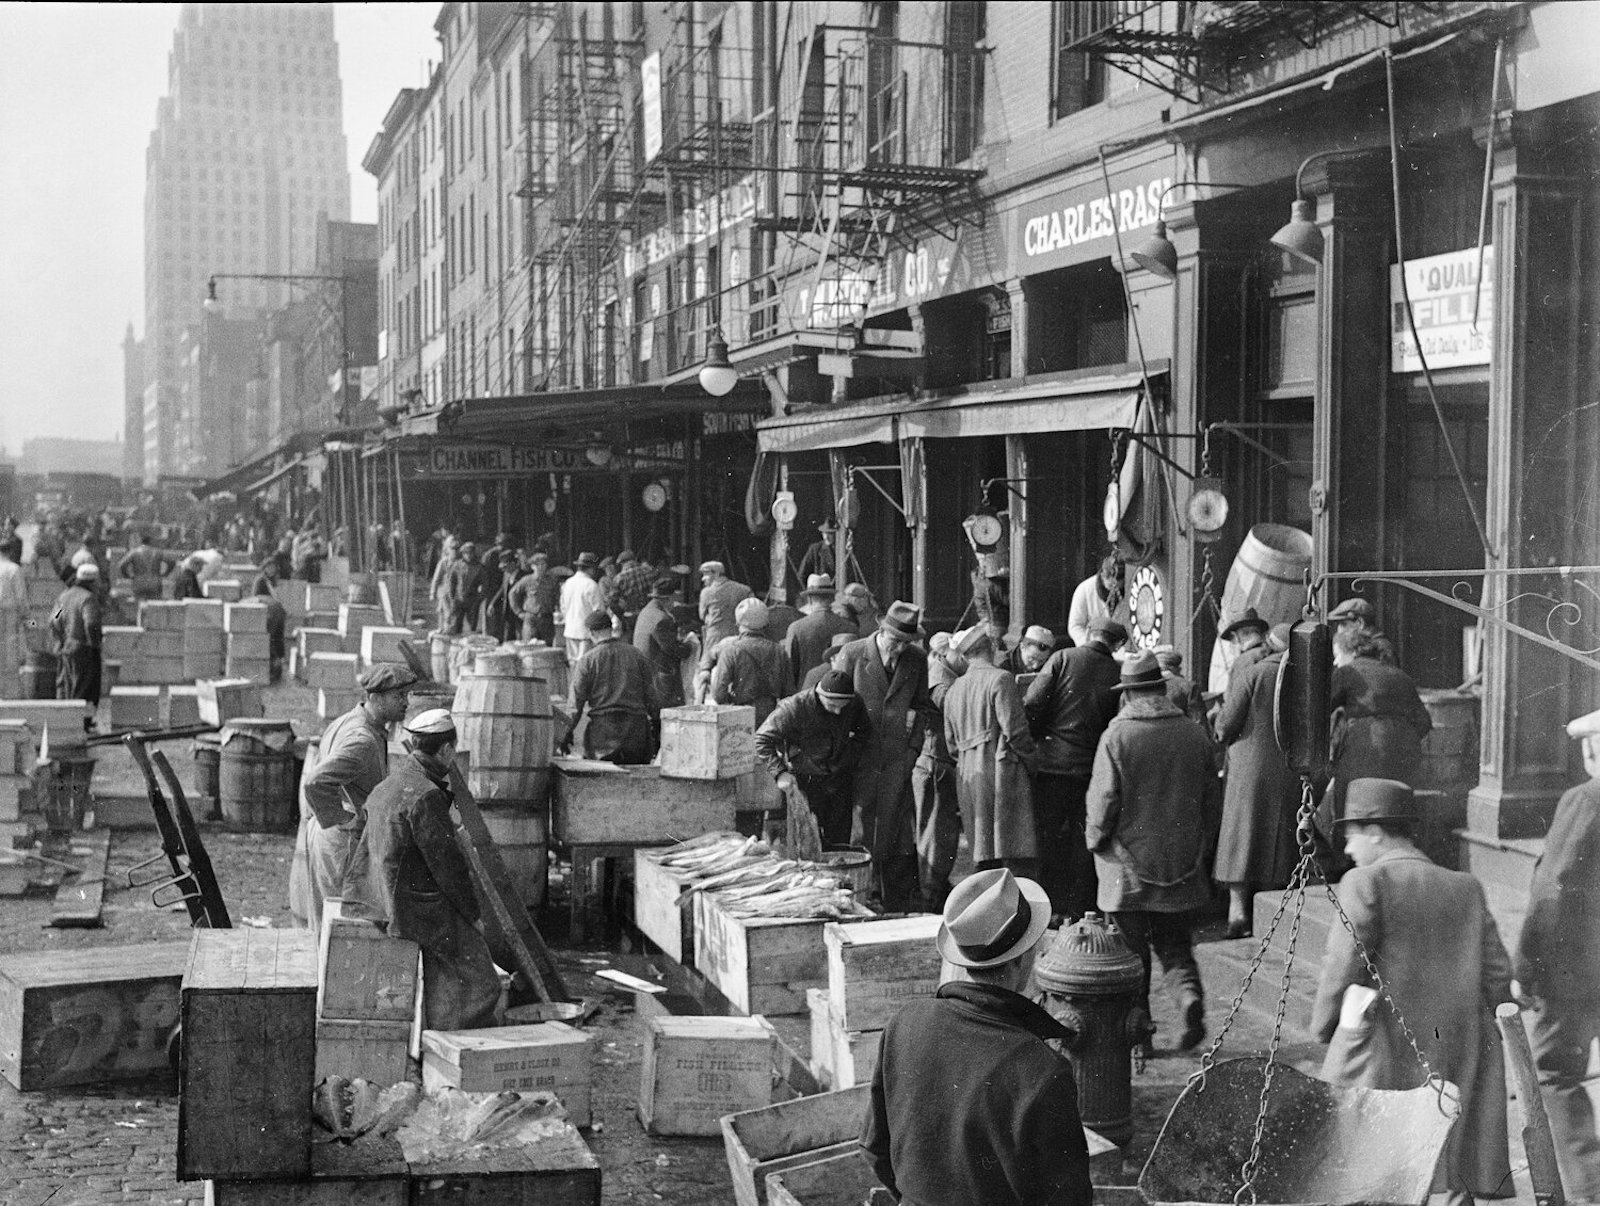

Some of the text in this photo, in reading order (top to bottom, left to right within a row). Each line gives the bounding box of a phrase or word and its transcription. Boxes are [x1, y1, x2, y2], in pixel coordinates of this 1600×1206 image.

[1024, 194, 1116, 256] CHARLES
[433, 448, 508, 471] CHANNEL
[511, 449, 548, 469] FISH
